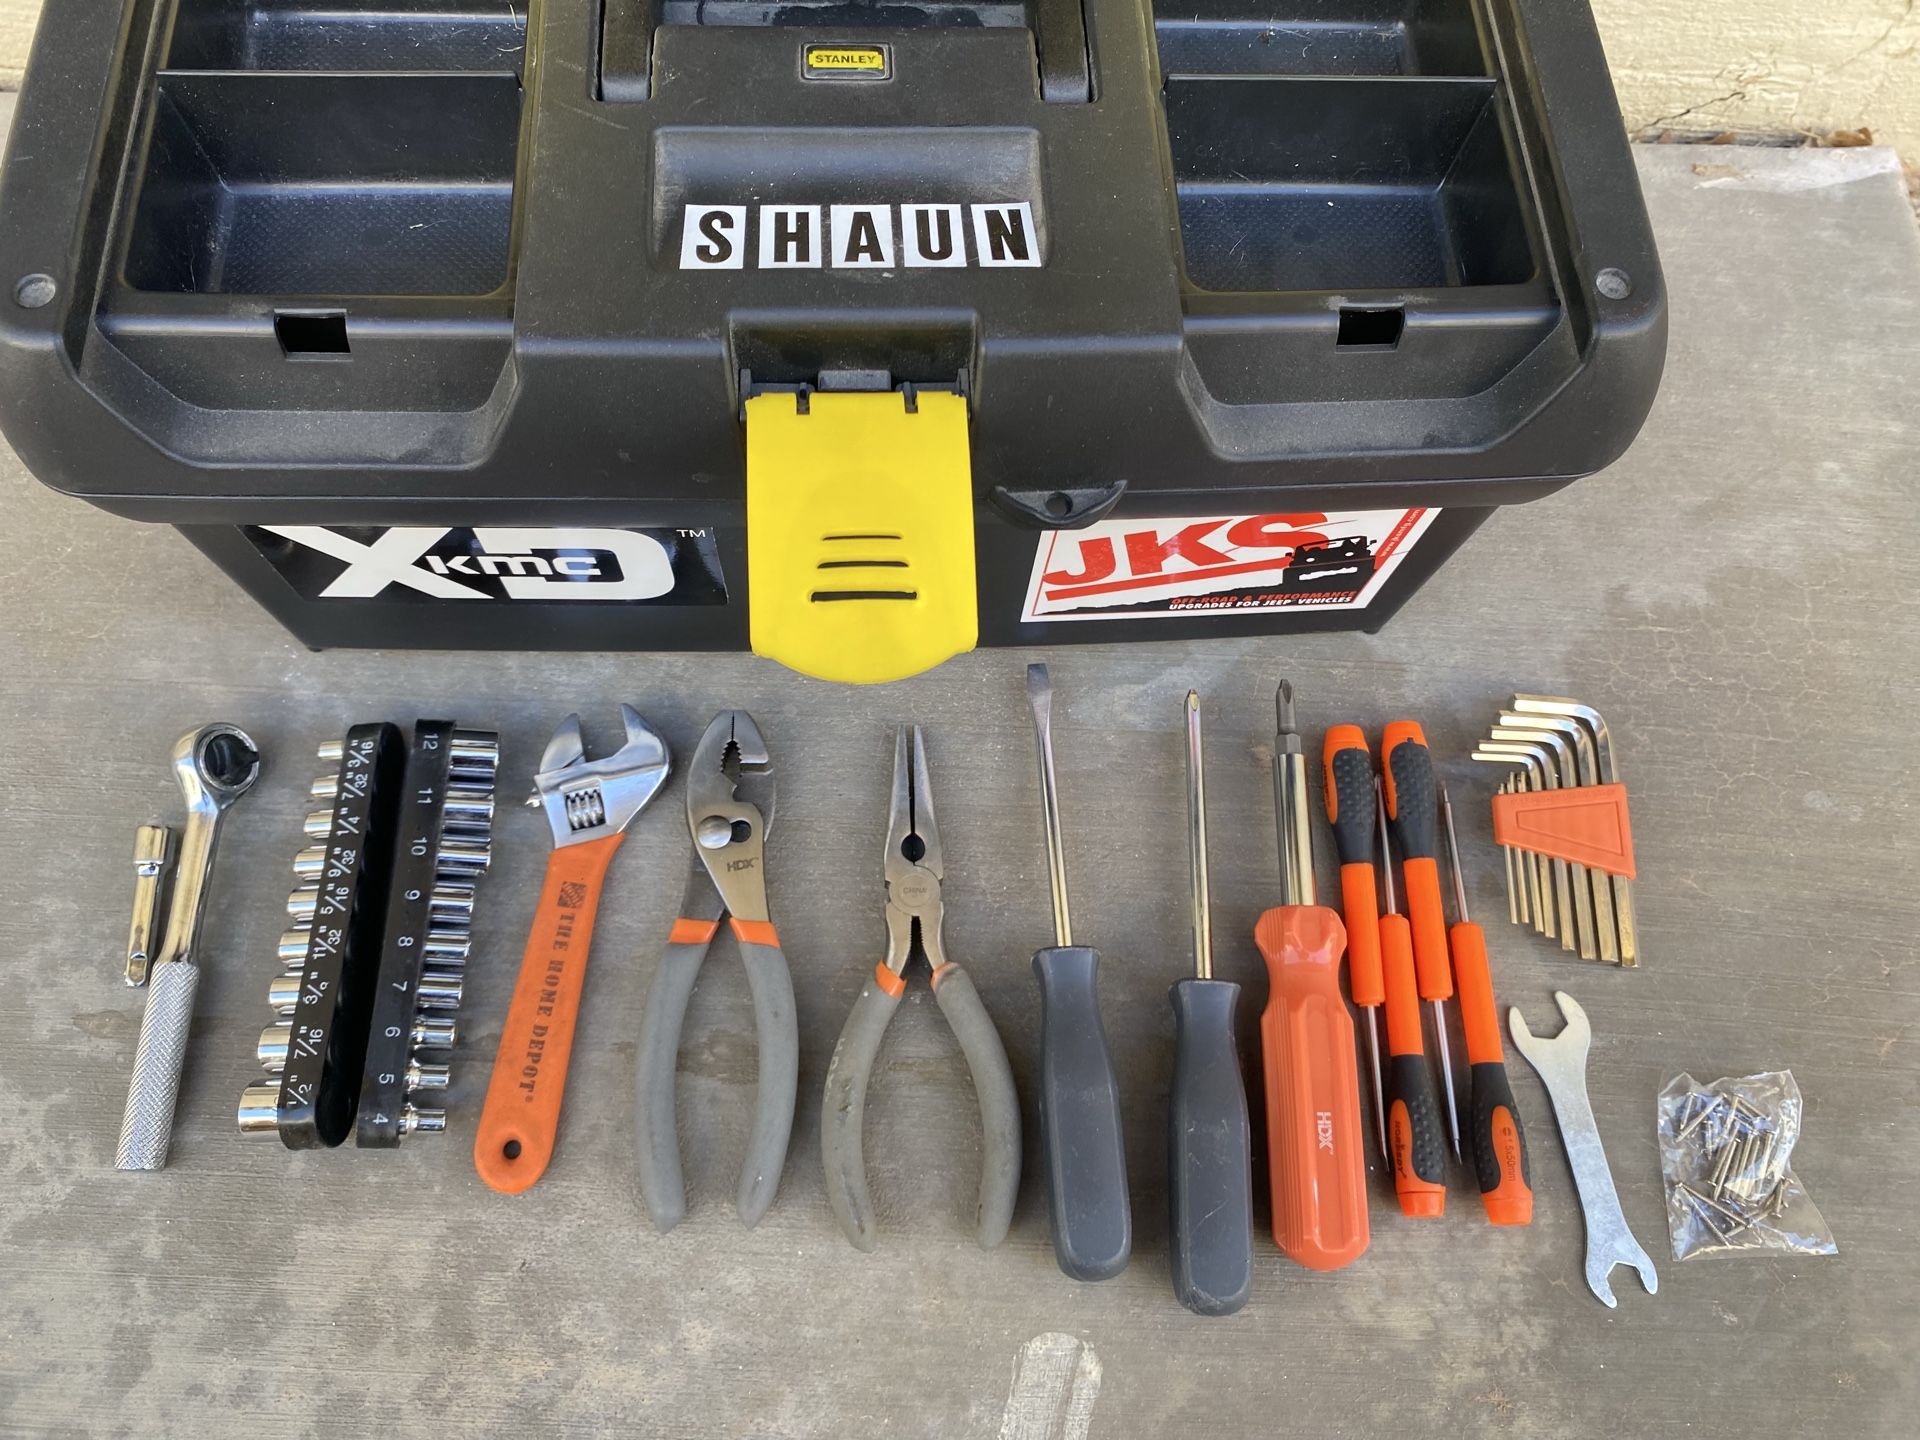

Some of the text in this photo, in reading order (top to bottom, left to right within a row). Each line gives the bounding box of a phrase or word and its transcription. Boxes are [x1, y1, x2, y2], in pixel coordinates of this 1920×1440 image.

[815, 54, 877, 65] STANLEY
[695, 209, 1030, 264] SHAUN
[1042, 512, 1329, 586] JKS
[1169, 601, 1232, 610] UPGRADES
[1236, 599, 1260, 608] FOR
[1298, 596, 1353, 605] VEHICLES
[1258, 590, 1357, 601] PERFORMANCE
[423, 733, 439, 750] 12
[416, 786, 433, 804] 11
[411, 836, 428, 856] 10
[727, 856, 759, 872] HDX
[404, 889, 421, 900] 9
[552, 913, 575, 951] THE
[397, 936, 414, 947] 8
[392, 980, 408, 992] 7
[536, 960, 565, 1017] HOME
[385, 1026, 401, 1038] 6
[378, 1073, 395, 1085] 5
[372, 1113, 389, 1125] 4
[1317, 1111, 1334, 1156] HDX
